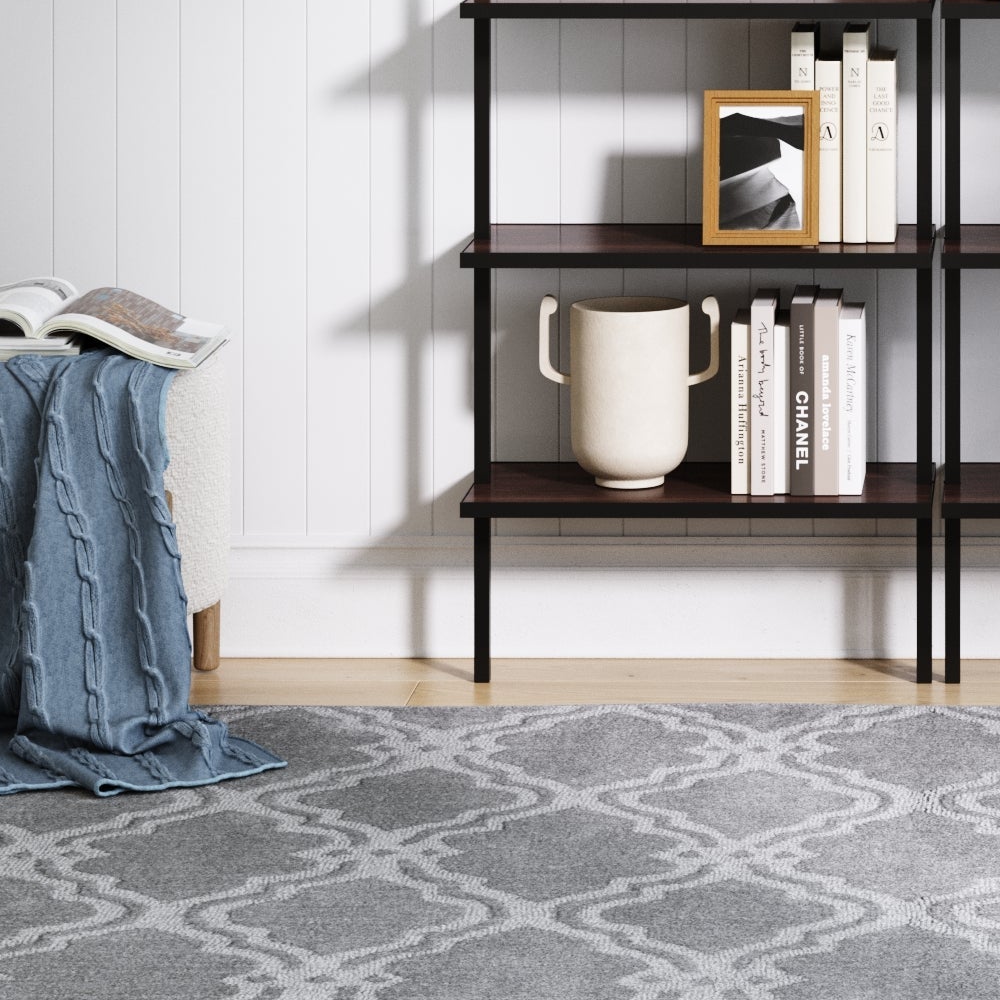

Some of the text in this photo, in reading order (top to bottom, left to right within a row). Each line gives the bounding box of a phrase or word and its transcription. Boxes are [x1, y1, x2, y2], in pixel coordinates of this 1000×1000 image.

[735, 355, 748, 464] Arianna Huffington
[752, 322, 771, 417] The body beyond
[799, 366, 804, 375] OF
[821, 354, 832, 451] amanda lovelace
[843, 333, 857, 412] Karen McCartney
[795, 390, 809, 471] CHANEL
